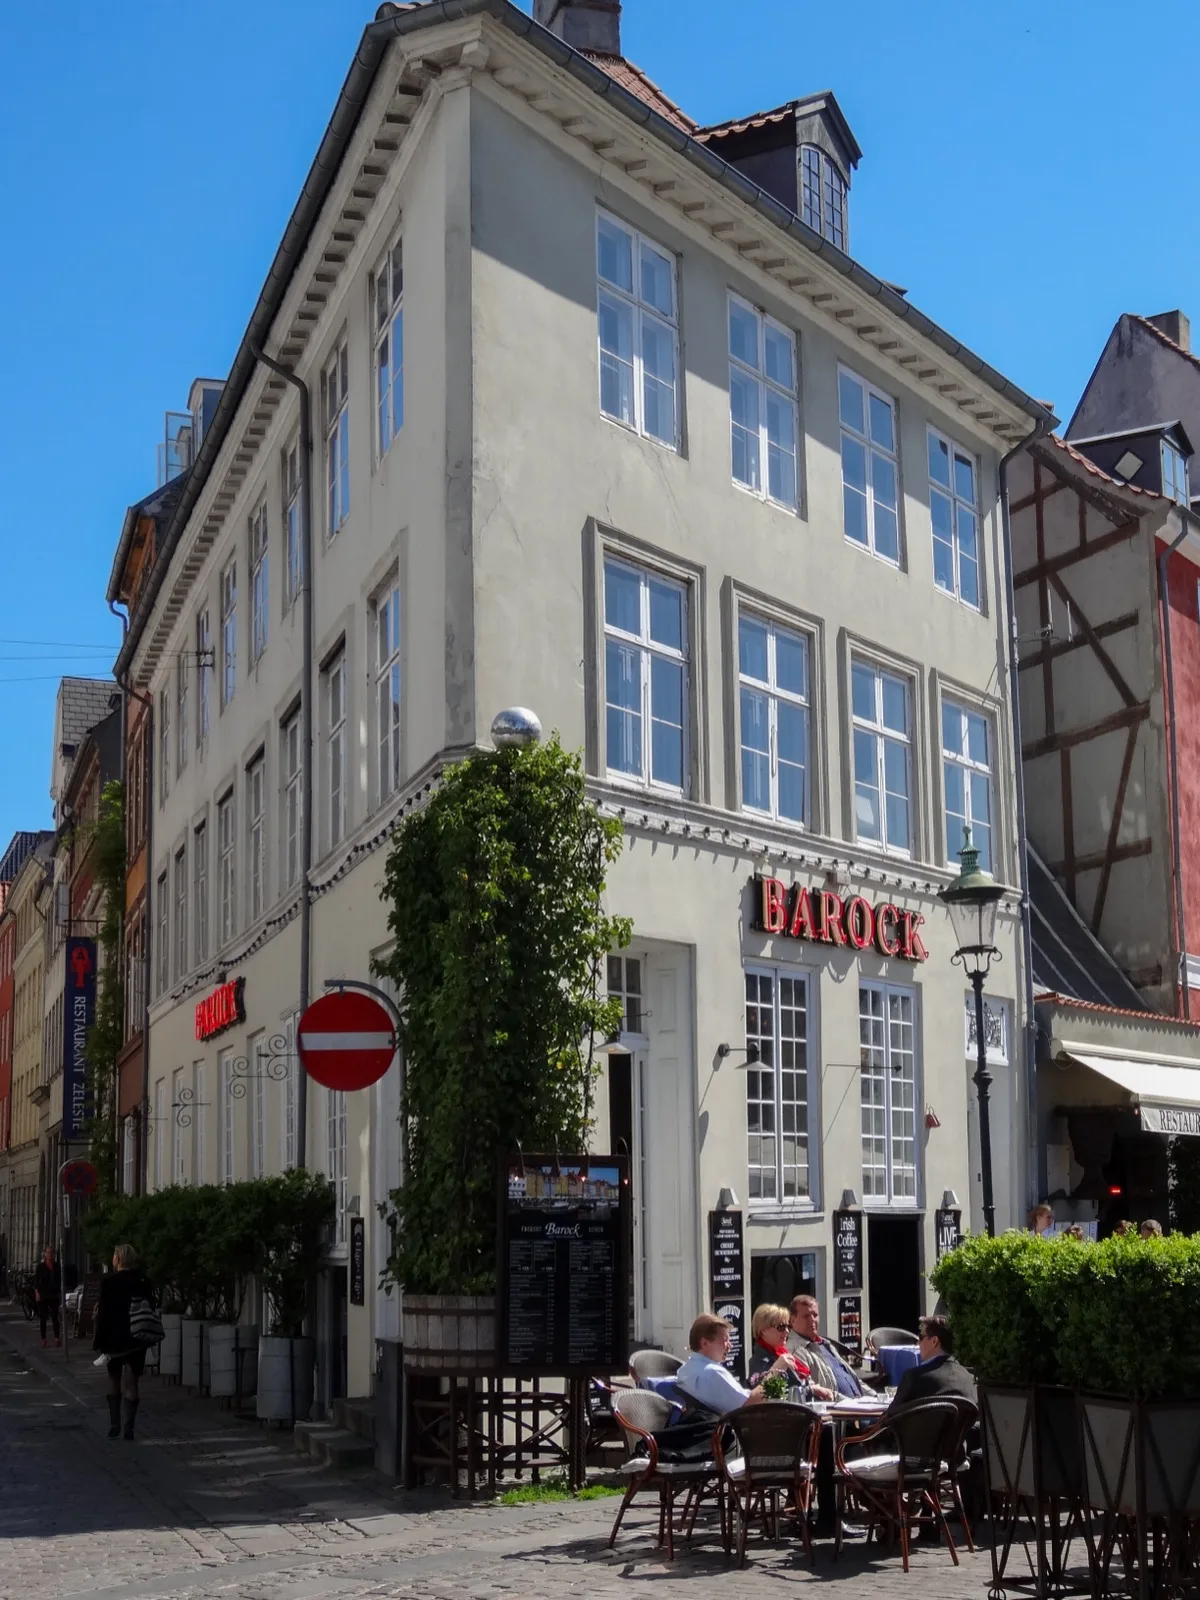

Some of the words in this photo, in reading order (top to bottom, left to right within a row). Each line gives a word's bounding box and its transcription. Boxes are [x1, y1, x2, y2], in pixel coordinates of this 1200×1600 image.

[755, 874, 929, 962] BAROCK
[73, 996, 87, 1074] RESTAURANT
[544, 1222, 583, 1238] Barock
[840, 1217, 856, 1231] Irish
[837, 1233, 858, 1247] Coffee
